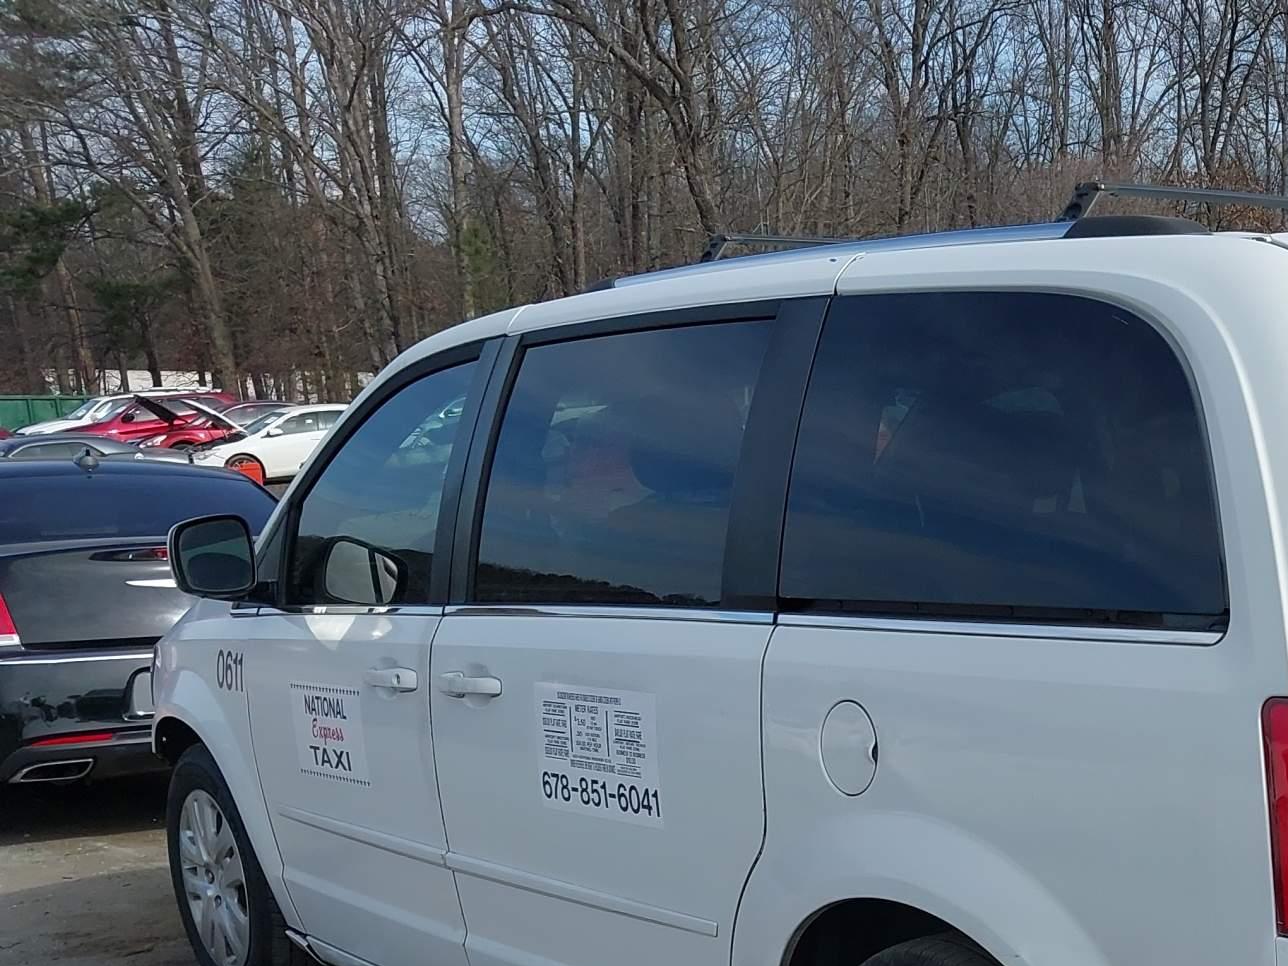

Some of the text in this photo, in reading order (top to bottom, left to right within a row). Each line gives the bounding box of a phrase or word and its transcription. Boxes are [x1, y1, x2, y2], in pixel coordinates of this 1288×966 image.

[216, 649, 244, 693] 0611
[304, 694, 347, 720] NATIONAL
[311, 718, 345, 746] Express
[309, 745, 352, 772] TAXI
[542, 771, 661, 818] 678-851-6041
